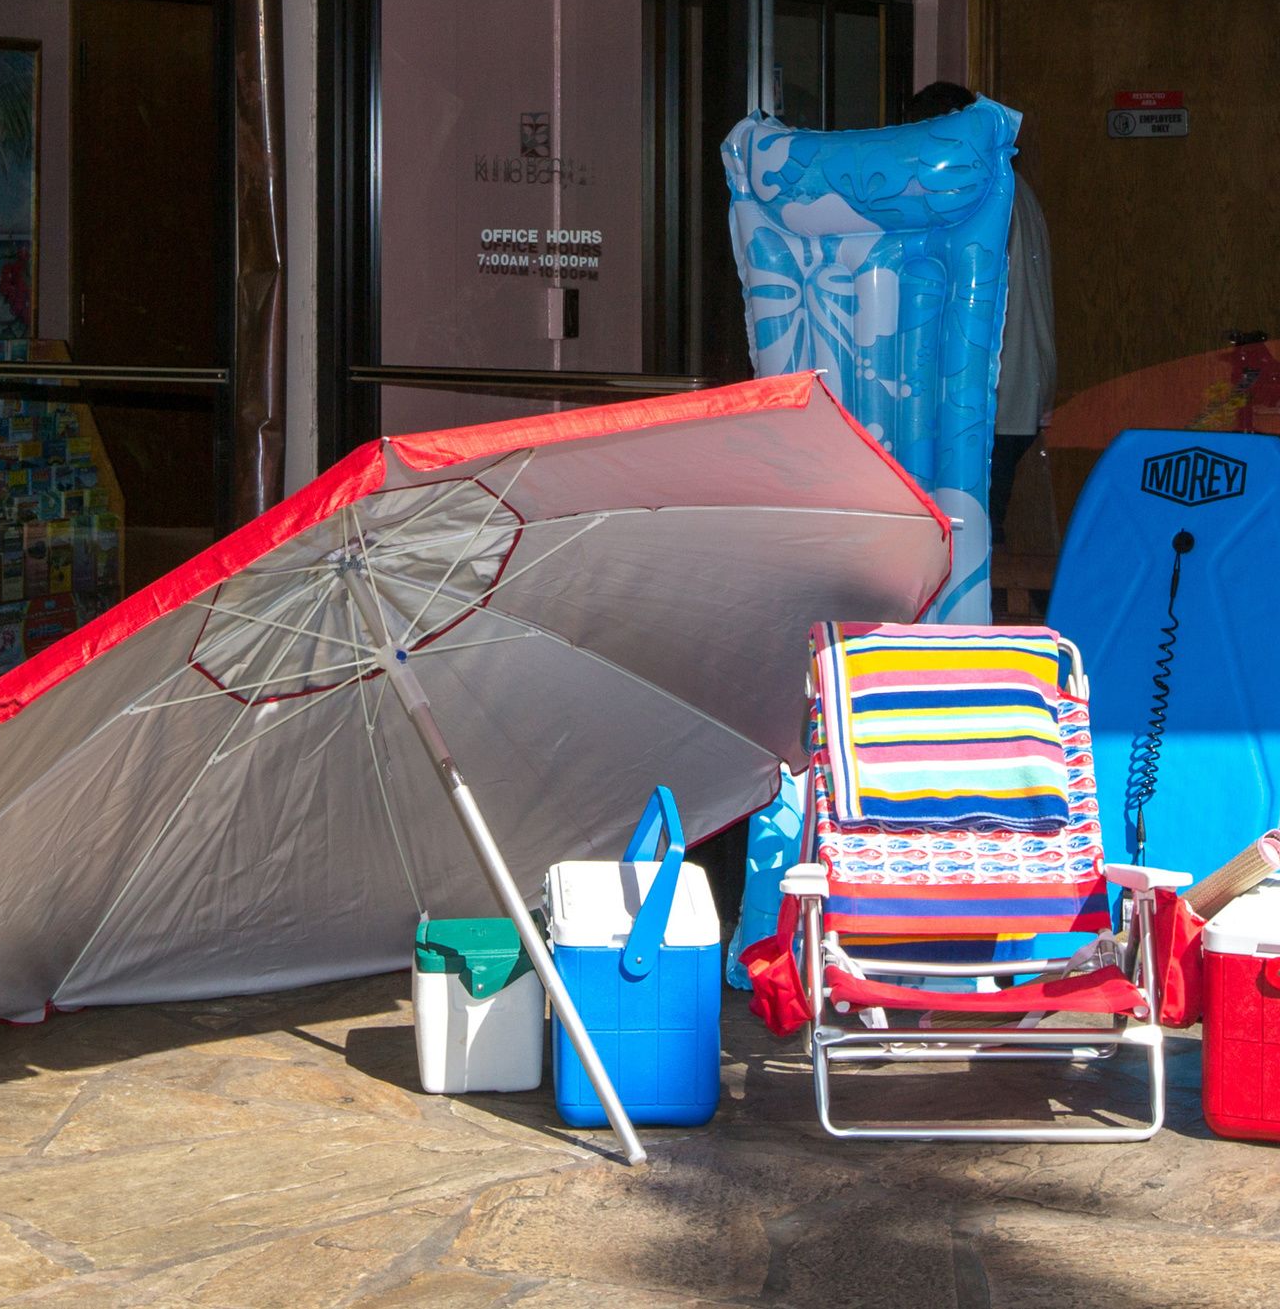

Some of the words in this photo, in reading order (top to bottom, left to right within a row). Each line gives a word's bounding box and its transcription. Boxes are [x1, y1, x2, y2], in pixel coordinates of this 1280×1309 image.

[1139, 114, 1182, 123] EMPLOYEES
[1151, 124, 1169, 133] ONLY
[481, 229, 538, 243] OFFICE
[546, 230, 602, 244] HOURS
[1148, 452, 1240, 500] MOREY
